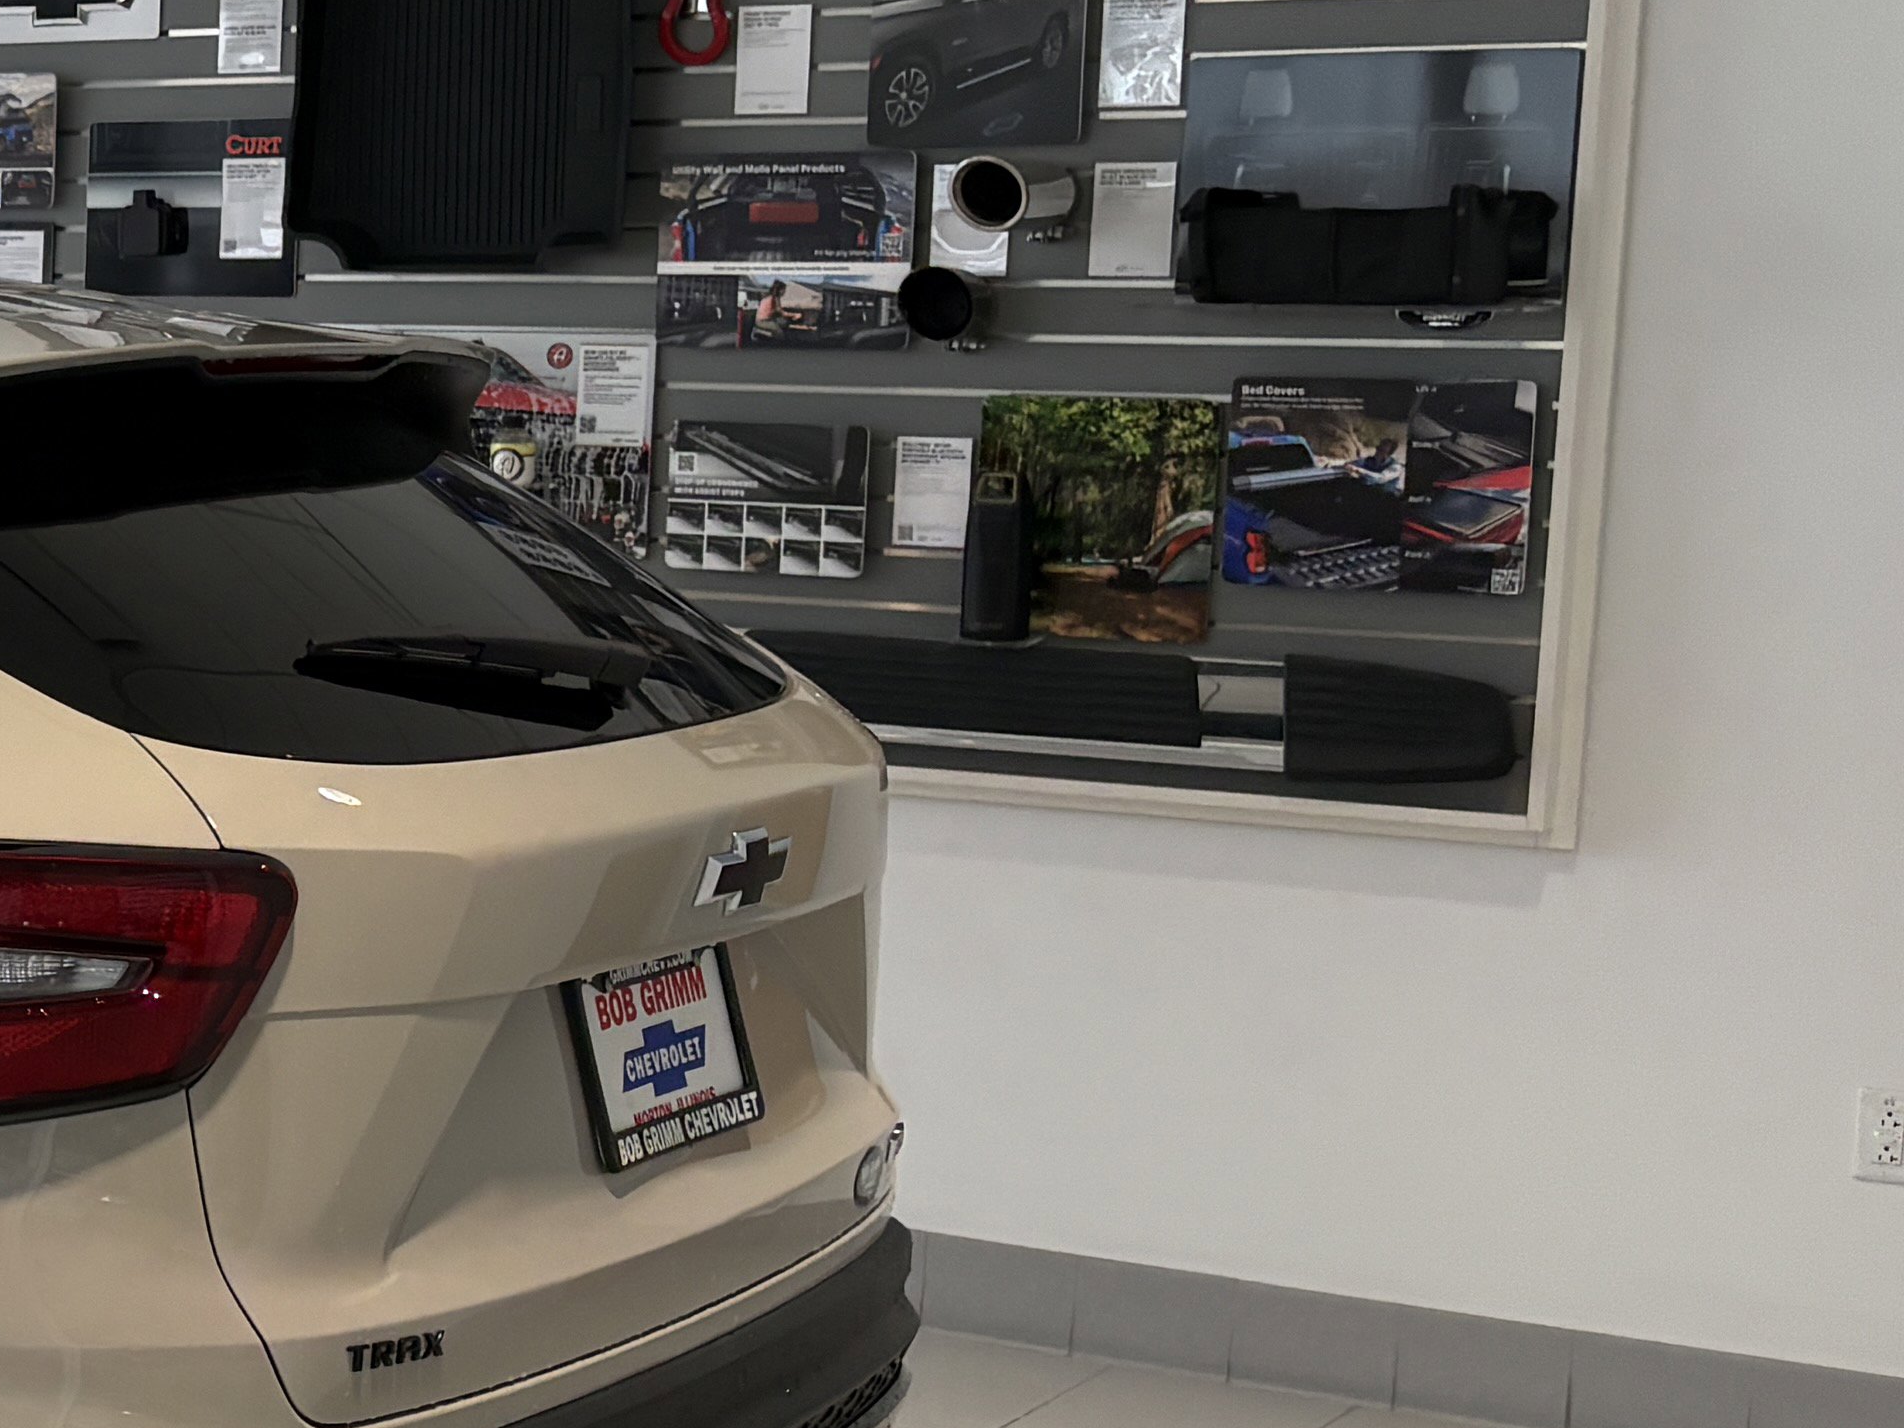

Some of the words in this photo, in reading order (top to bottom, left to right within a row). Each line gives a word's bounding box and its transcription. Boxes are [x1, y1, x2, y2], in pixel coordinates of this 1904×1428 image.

[225, 134, 282, 155] CURT
[595, 986, 637, 1031] BOB
[640, 965, 707, 1016] GRIMM
[625, 1036, 703, 1083] CHEVROLET
[617, 1132, 643, 1166] BOB
[643, 1117, 686, 1155] GRIMM
[684, 1091, 759, 1140] CHEVROLET
[346, 1330, 445, 1372] TRAX
